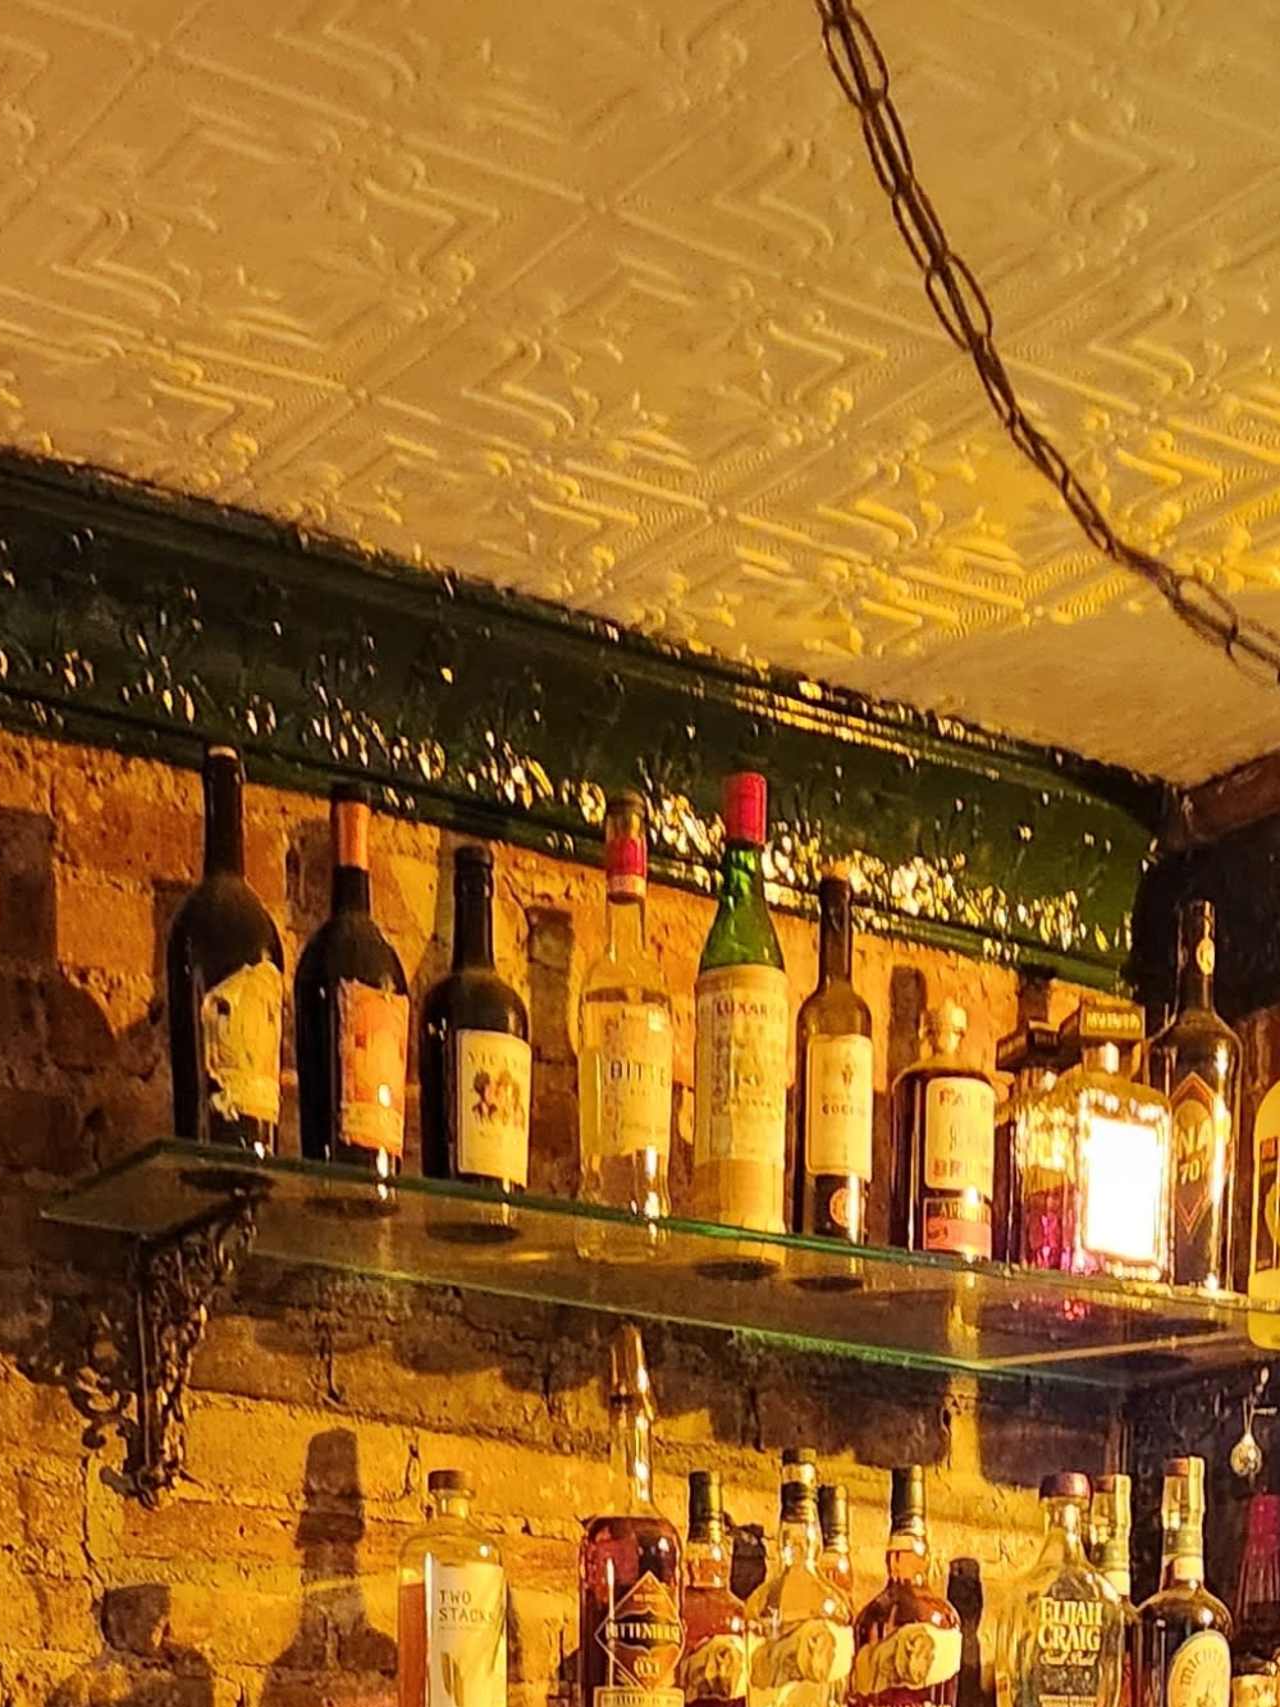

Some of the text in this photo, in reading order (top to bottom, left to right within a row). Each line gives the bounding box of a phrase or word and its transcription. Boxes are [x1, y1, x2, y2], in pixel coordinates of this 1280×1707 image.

[440, 1590, 472, 1605] TWO
[439, 1607, 495, 1625] STACKS
[1039, 1597, 1103, 1627] ELIJAH
[1037, 1624, 1102, 1651] CRAIG
